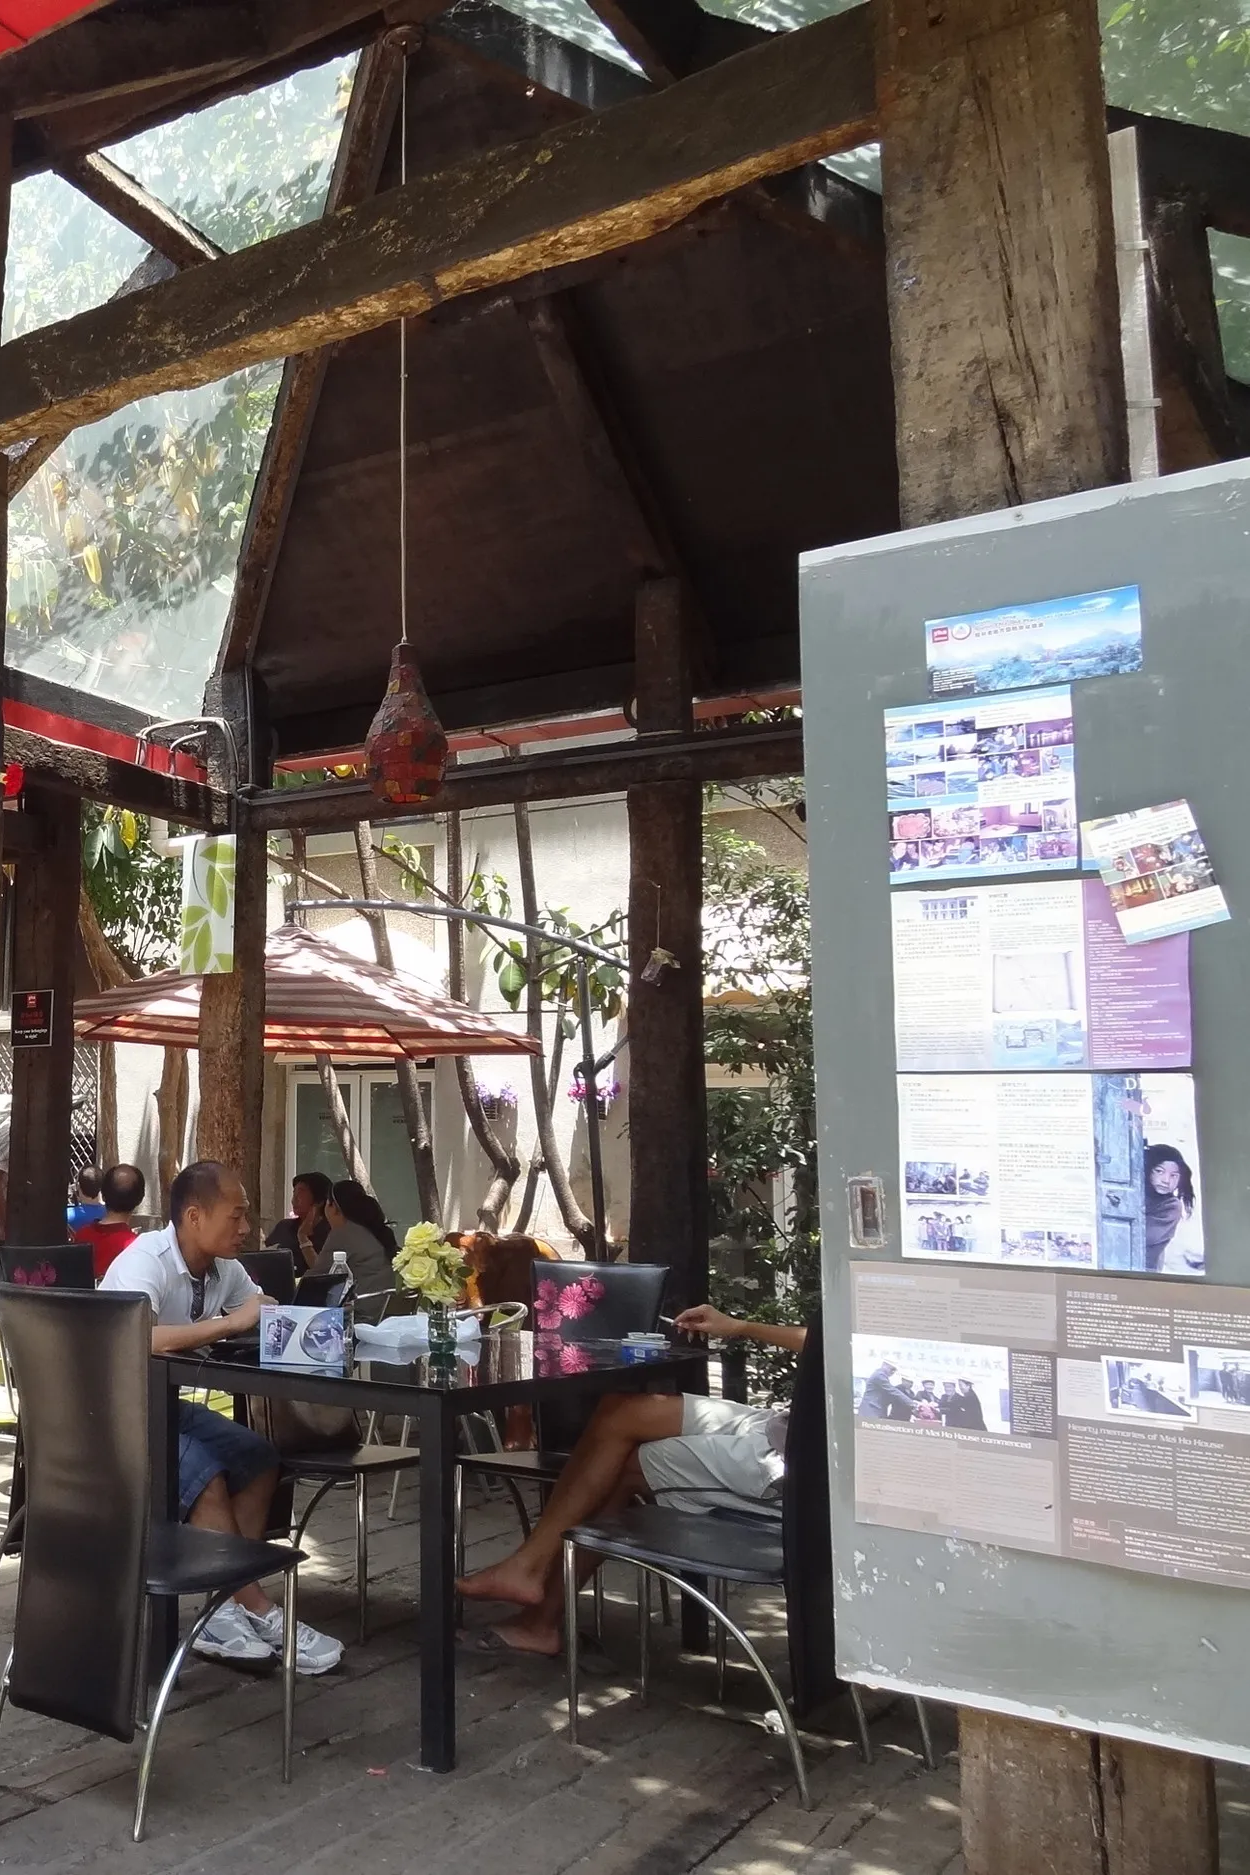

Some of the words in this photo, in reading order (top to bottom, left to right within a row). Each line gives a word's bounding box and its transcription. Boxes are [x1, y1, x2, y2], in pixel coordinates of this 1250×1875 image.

[861, 1421, 915, 1434] Revitalisation
[915, 1428, 924, 1436] of
[925, 1428, 941, 1438] Mei
[942, 1430, 953, 1440] Ho
[954, 1432, 981, 1443] House
[981, 1437, 1032, 1450] commenced
[1068, 1422, 1099, 1435] Hearty
[1099, 1427, 1146, 1440] memories
[1147, 1433, 1158, 1441] of
[1159, 1434, 1177, 1444] Mei
[1178, 1437, 1192, 1446] Ho
[1193, 1439, 1225, 1450] House
